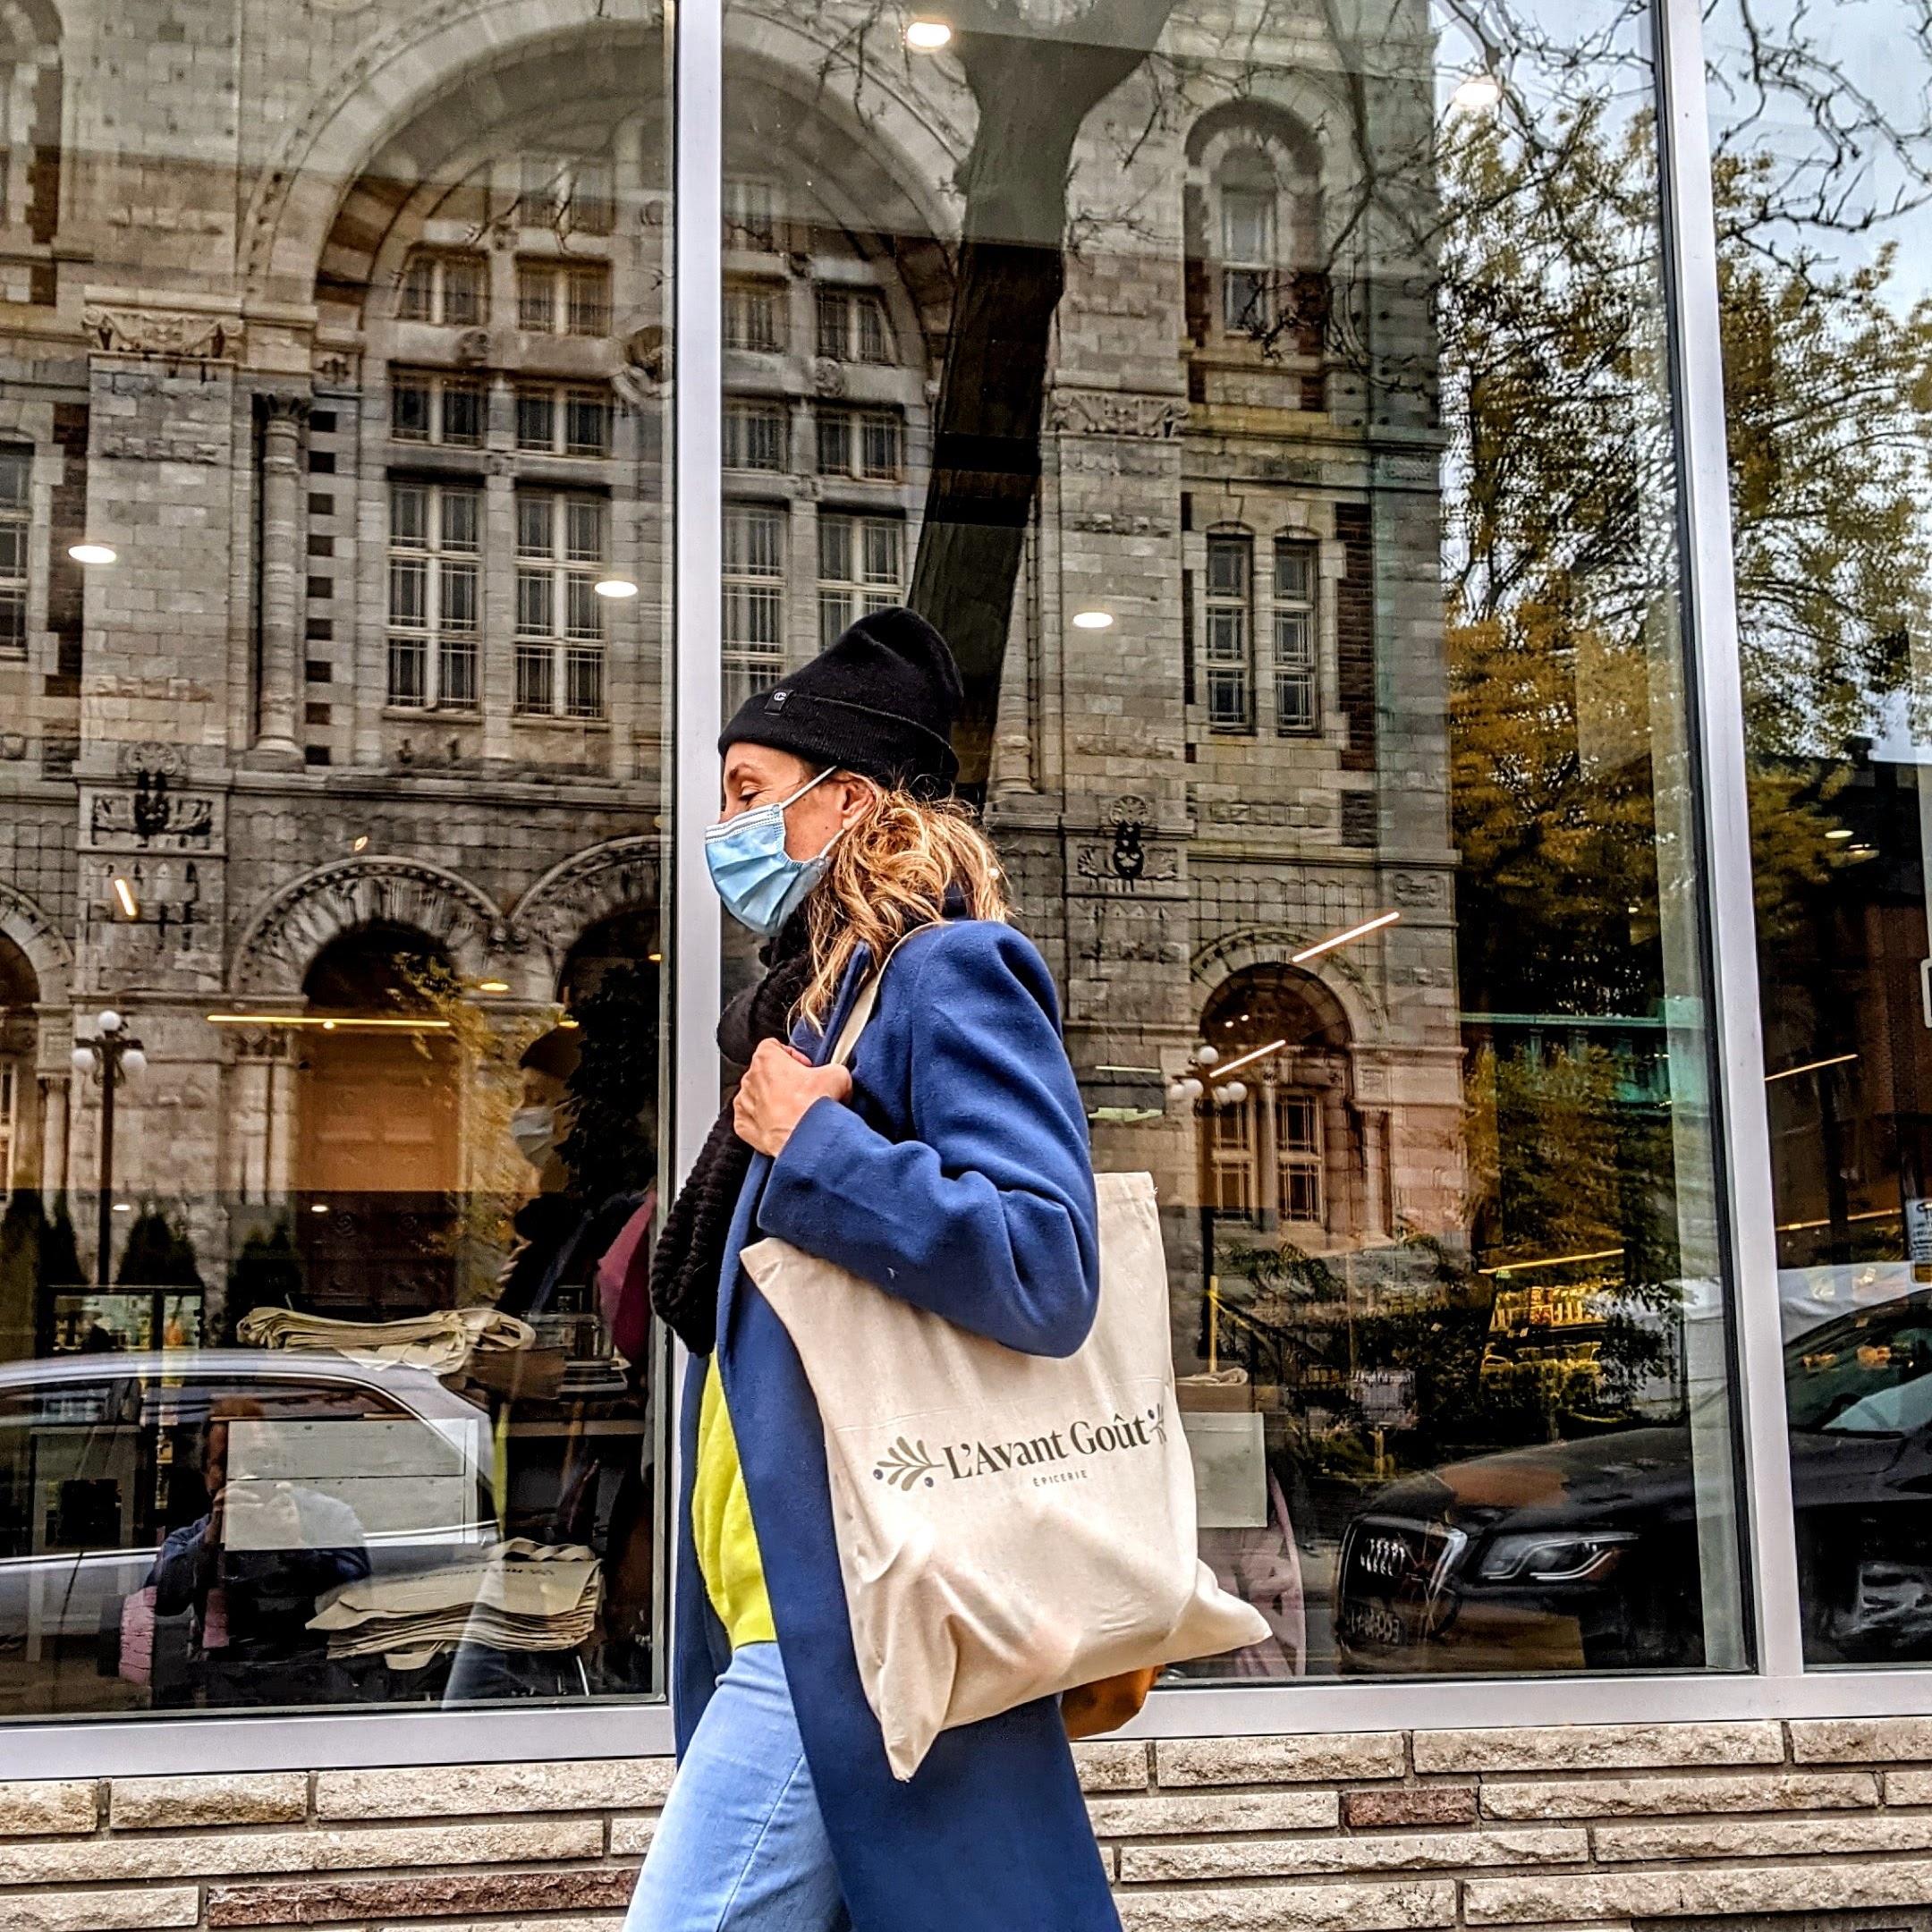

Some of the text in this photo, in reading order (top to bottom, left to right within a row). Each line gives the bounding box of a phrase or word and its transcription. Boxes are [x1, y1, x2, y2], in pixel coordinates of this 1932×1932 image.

[942, 1413, 1151, 1479] L'Avant Goût
[1033, 1470, 1089, 1487] ÉPICERIE
